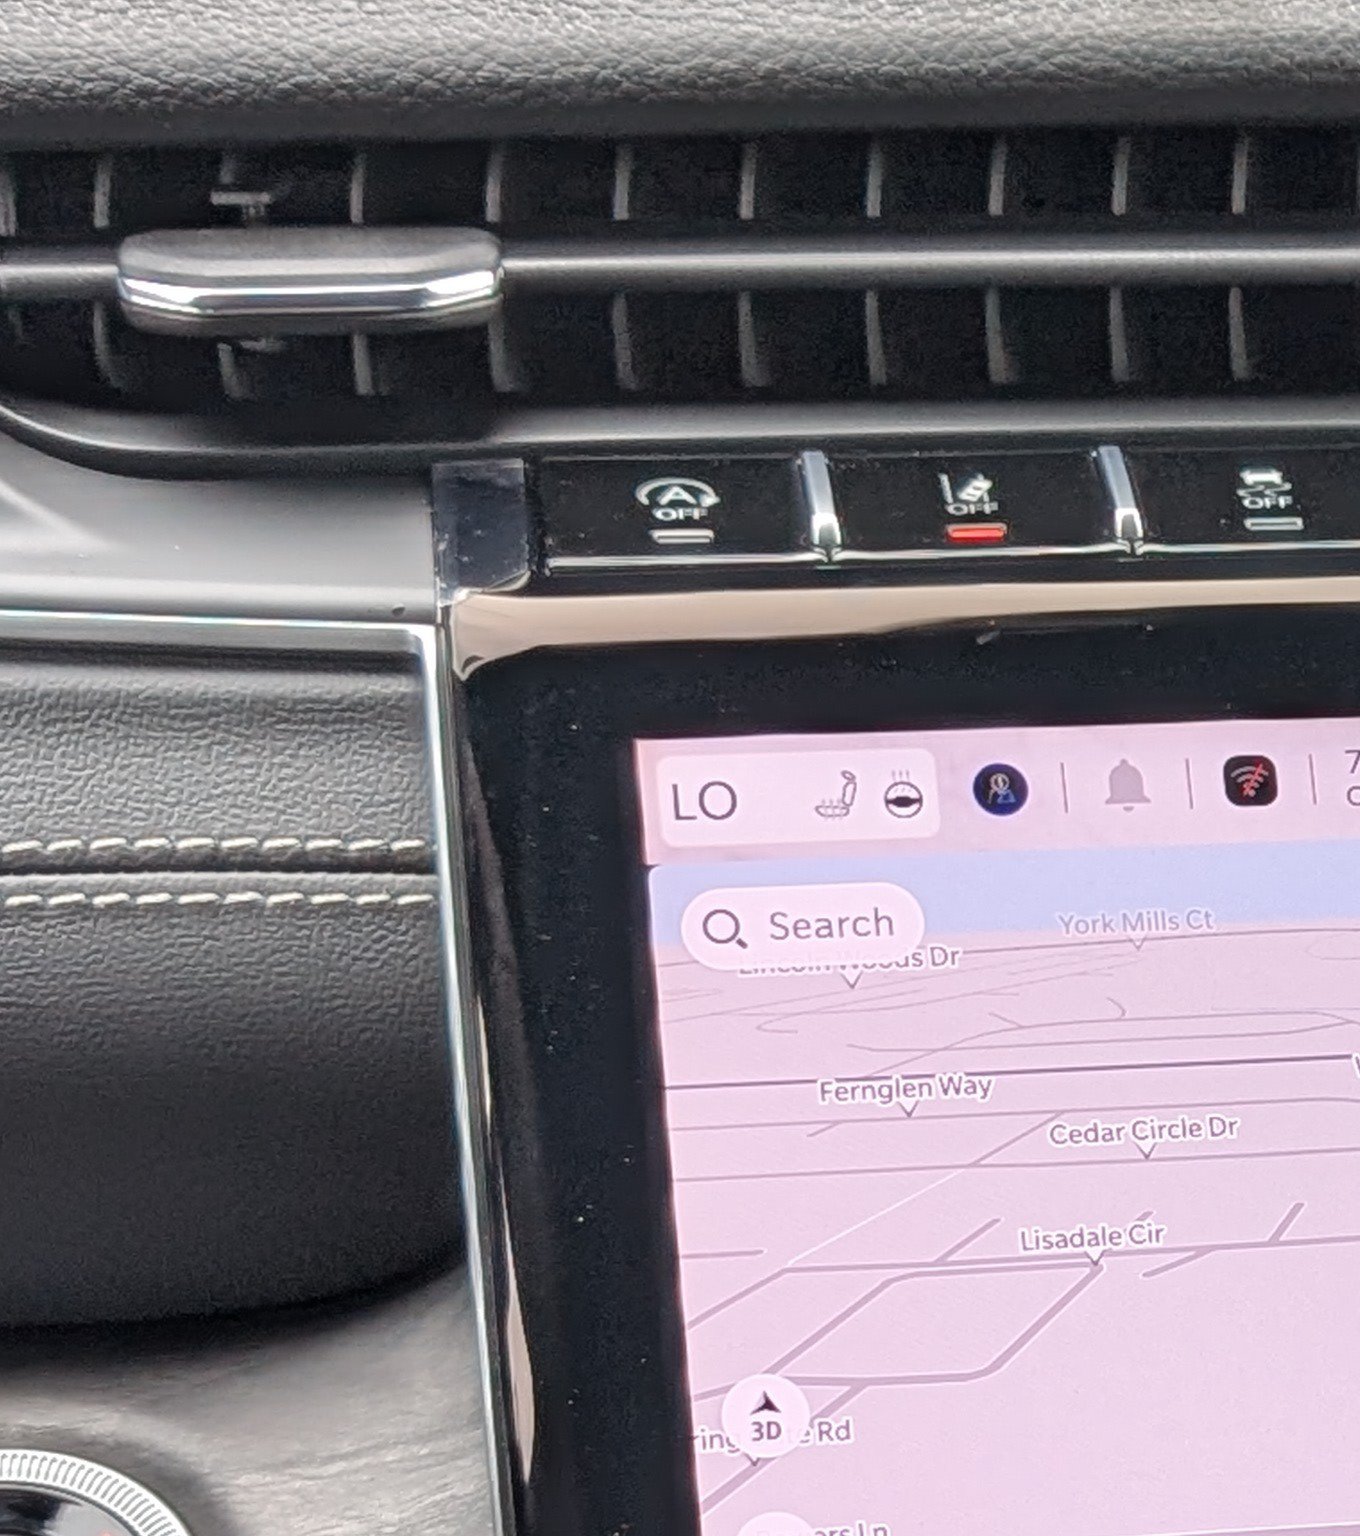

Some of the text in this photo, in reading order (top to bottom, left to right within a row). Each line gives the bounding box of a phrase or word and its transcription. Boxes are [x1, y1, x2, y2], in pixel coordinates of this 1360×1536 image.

[653, 507, 709, 521] OFF
[944, 502, 998, 515] OFF
[1241, 495, 1294, 509] OFF
[671, 780, 738, 821] LO
[769, 907, 895, 941] Search
[1060, 909, 1215, 936] York Mills Ct
[930, 946, 961, 967] Dr
[820, 1075, 992, 1106] Fernglen Way
[1049, 1116, 1239, 1145] Cedar Circle Dr
[1020, 1223, 1165, 1251] Lisadale Cir
[751, 1420, 782, 1442] 3D
[818, 1419, 851, 1442] Rd
